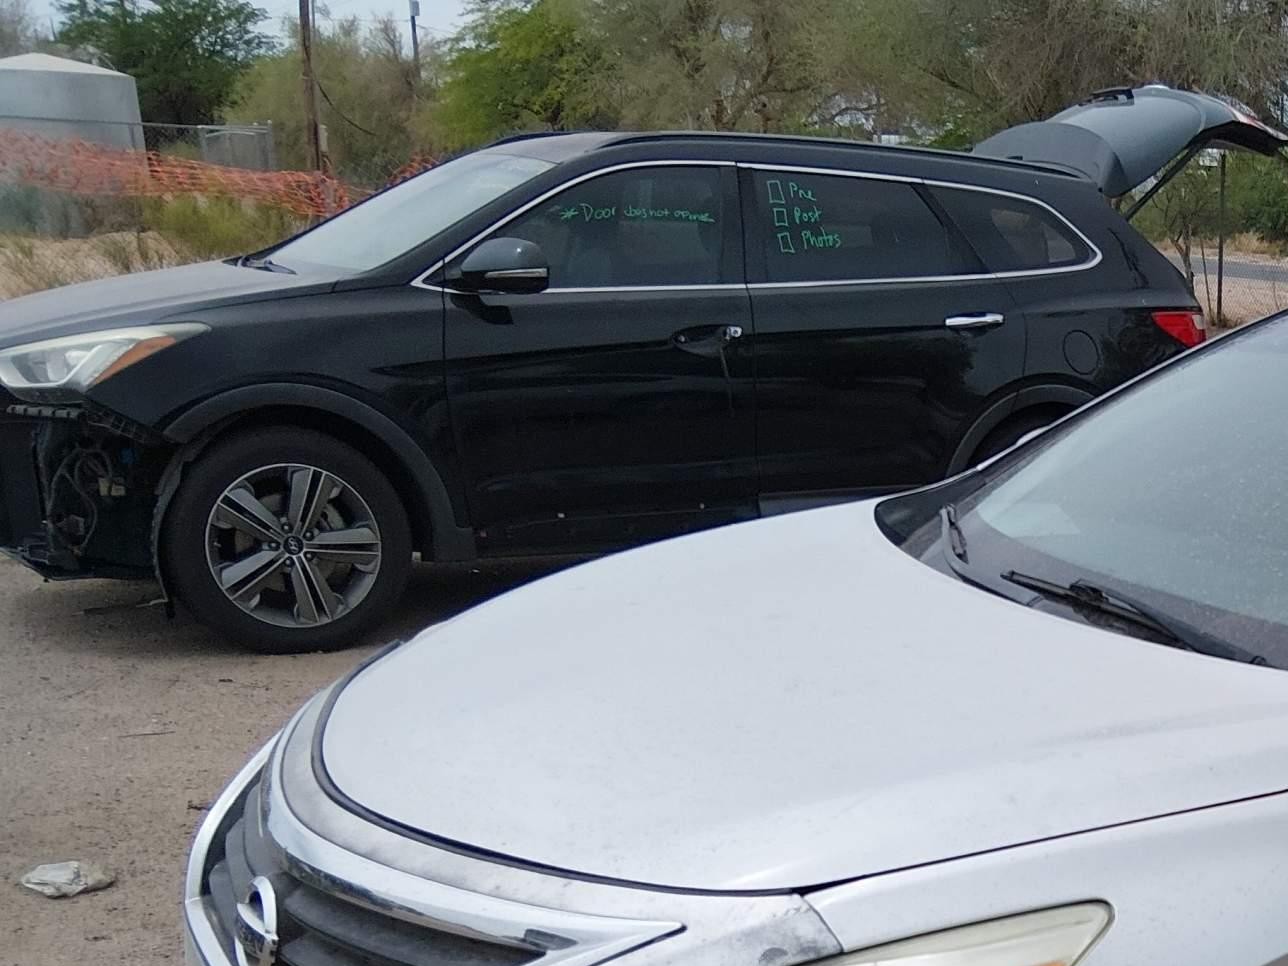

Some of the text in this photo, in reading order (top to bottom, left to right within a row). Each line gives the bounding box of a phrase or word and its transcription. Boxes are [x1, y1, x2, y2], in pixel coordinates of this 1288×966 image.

[789, 182, 817, 201] Pre
[580, 203, 617, 222] Door
[793, 205, 822, 225] Post
[801, 226, 842, 250] Photos
